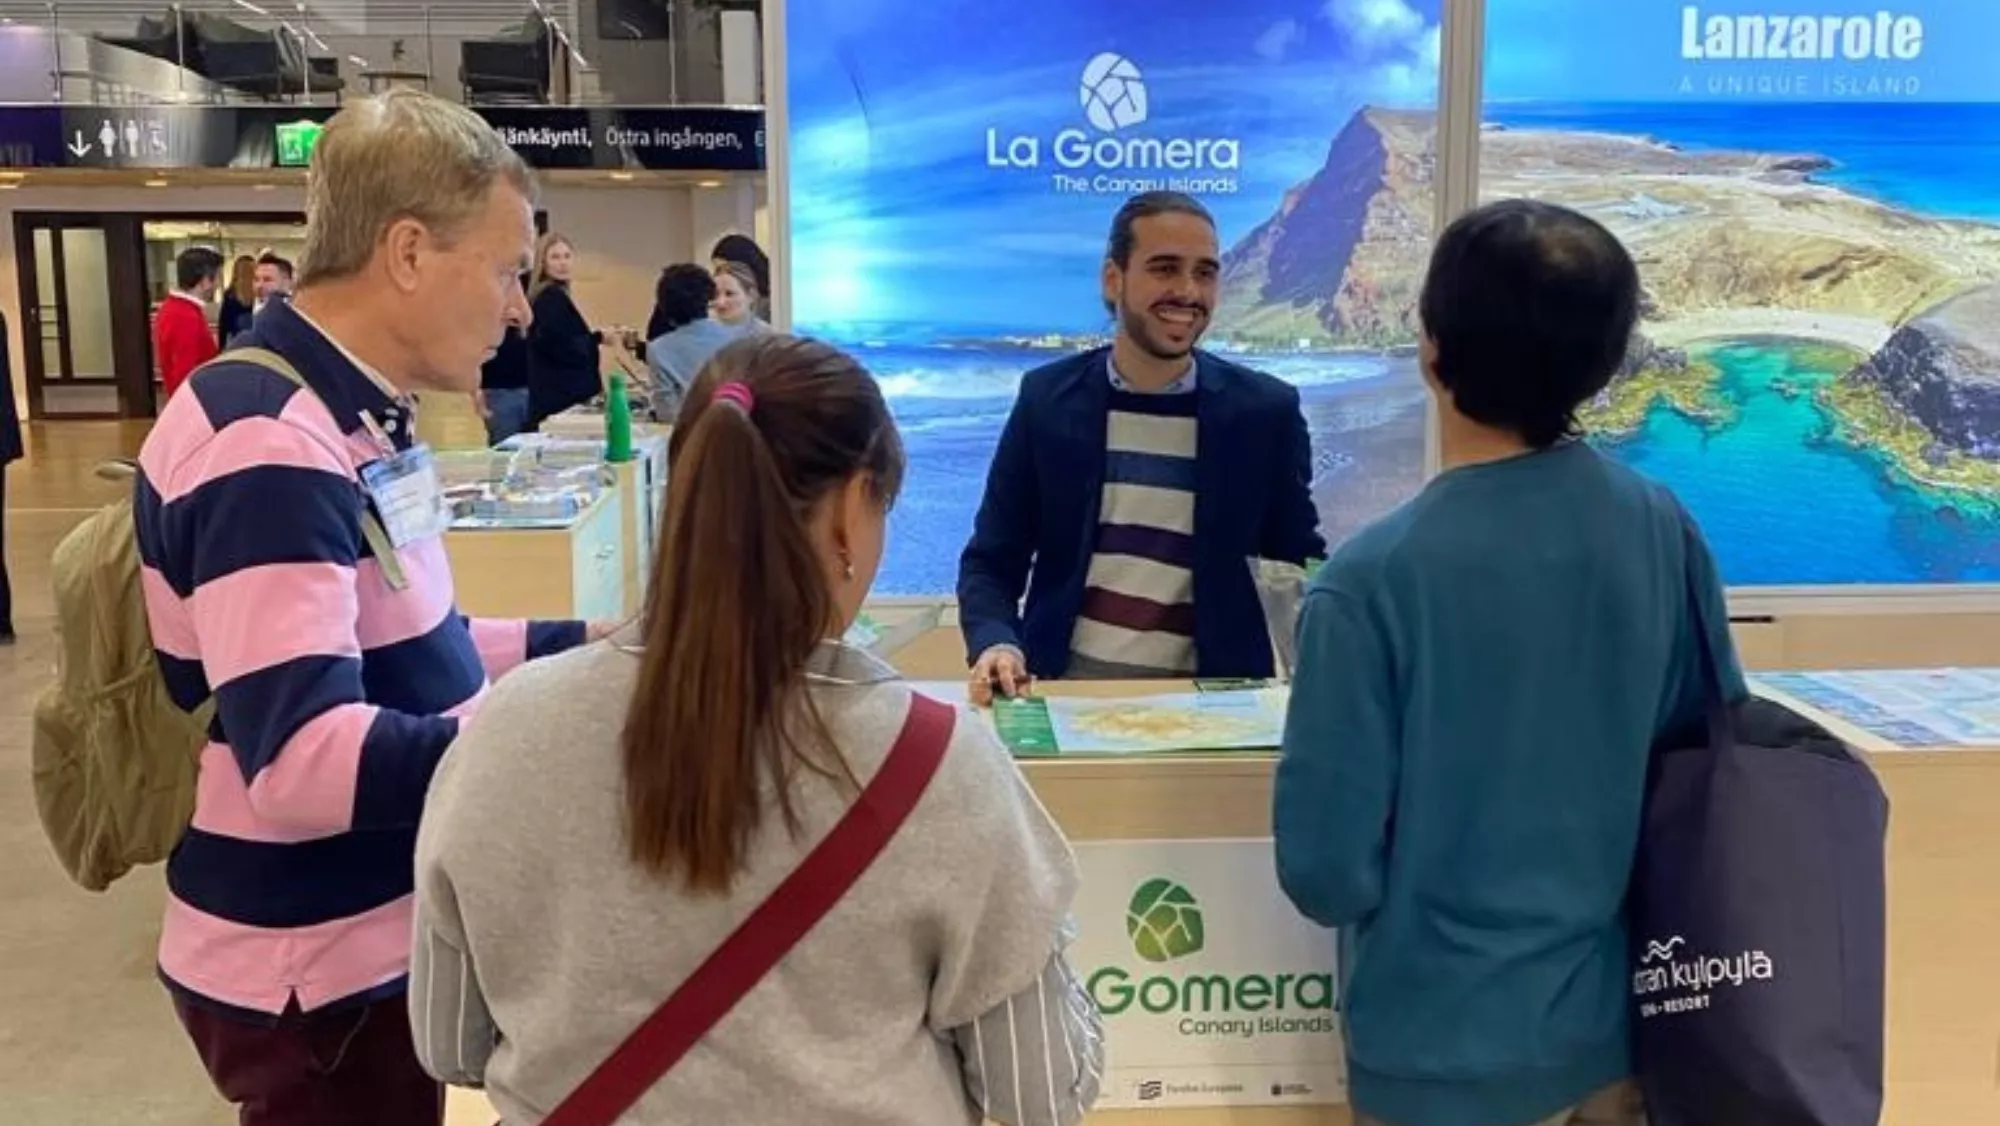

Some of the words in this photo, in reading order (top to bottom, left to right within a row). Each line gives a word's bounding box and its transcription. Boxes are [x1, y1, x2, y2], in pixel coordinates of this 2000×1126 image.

[1681, 5, 1923, 59] Lanzarote
[1680, 76, 1694, 94] A
[1707, 75, 1808, 95] UNIQUE
[1822, 75, 1921, 95] ISLAND
[605, 124, 650, 147] Östra
[654, 125, 742, 149] ingången,
[985, 127, 1039, 168] La
[1053, 128, 1240, 169] Gomera
[1052, 175, 1089, 193] The
[1168, 174, 1237, 193] Islands
[1671, 950, 1773, 991] kylpylä
[1085, 966, 1334, 1015] Gomera
[1178, 1017, 1252, 1038] Canary
[1258, 1015, 1334, 1033] Islands
